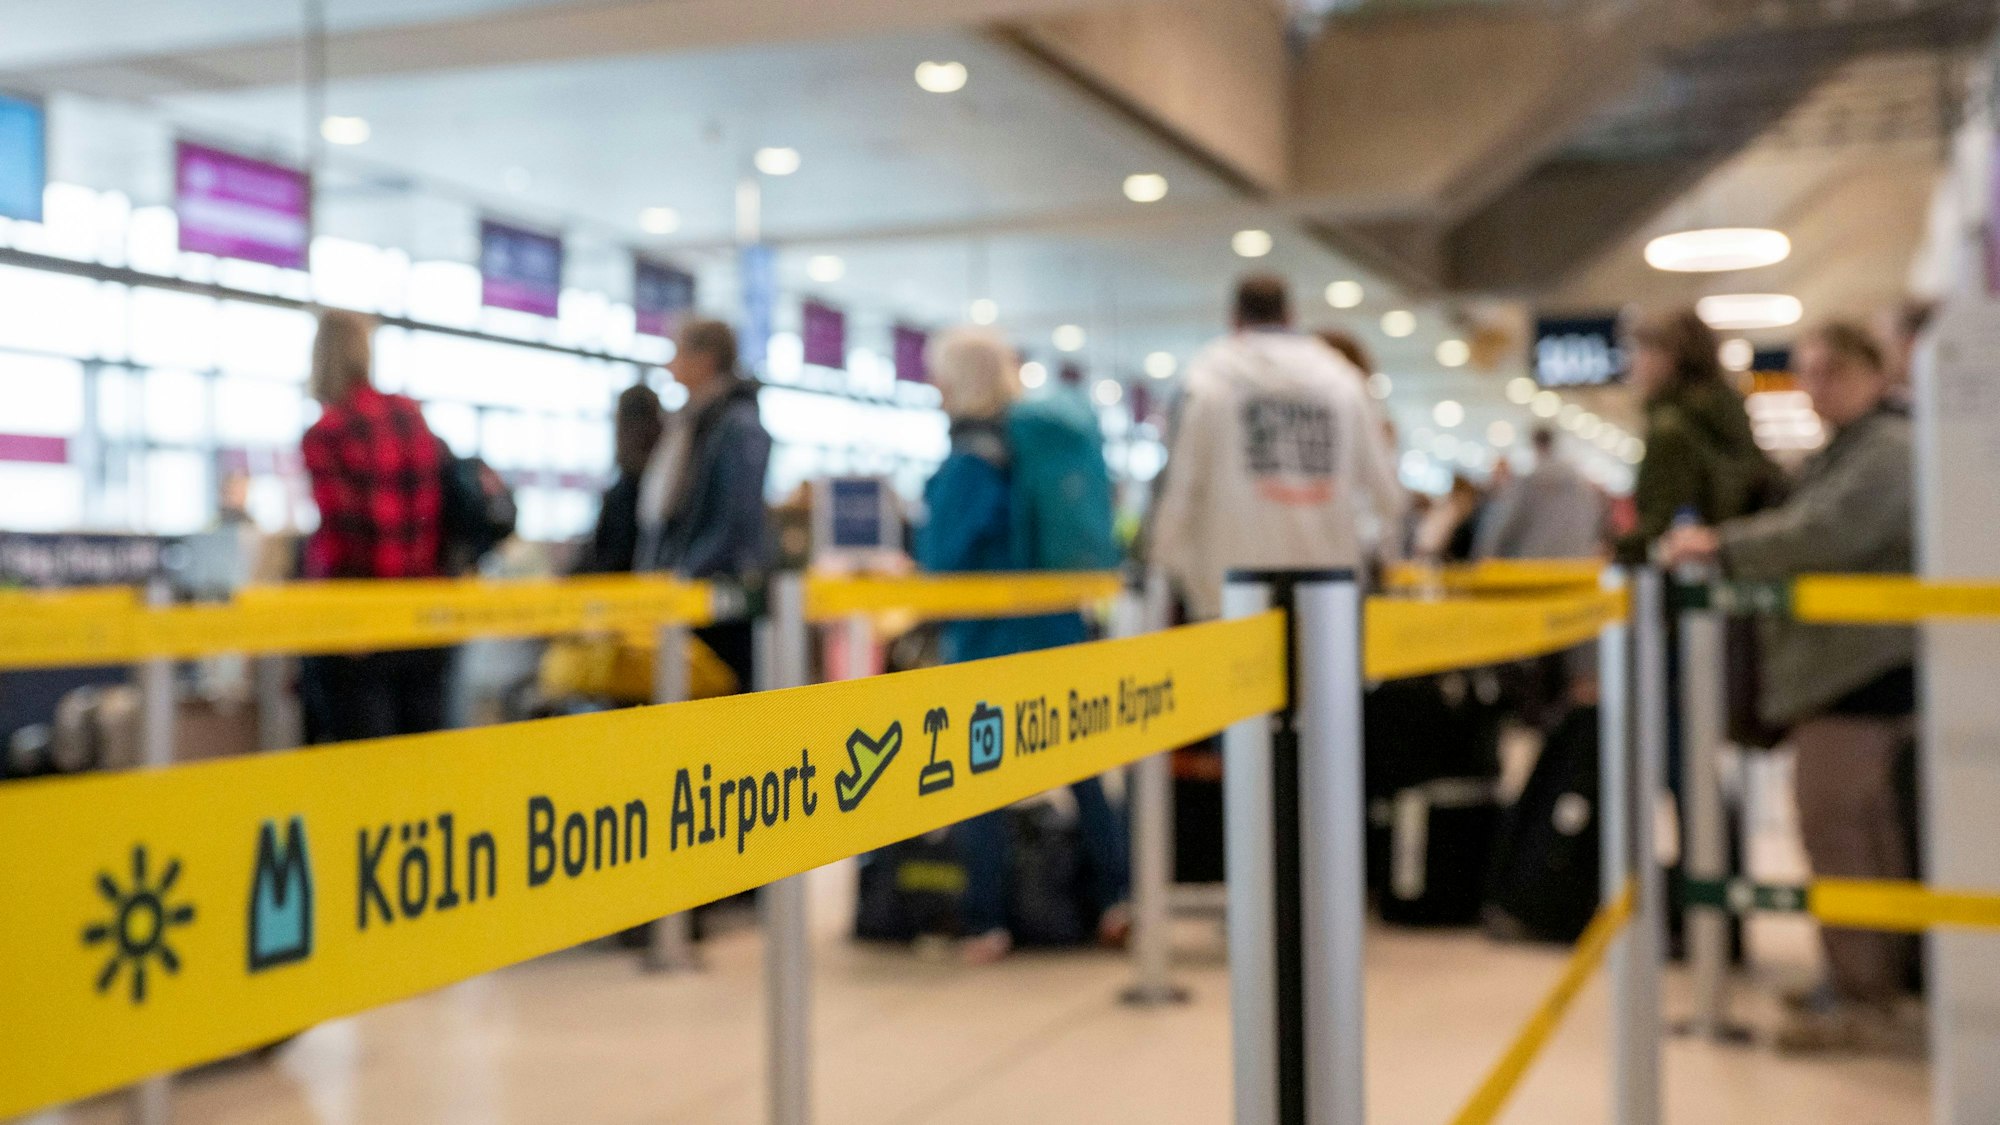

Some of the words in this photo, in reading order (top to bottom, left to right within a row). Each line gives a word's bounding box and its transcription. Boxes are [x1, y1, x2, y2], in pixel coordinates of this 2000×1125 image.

[1014, 695, 1060, 757] Köln
[1068, 689, 1110, 742] Bonn
[1117, 676, 1175, 732] Airport
[356, 812, 497, 931] Köln
[527, 796, 648, 887] Bonn
[670, 748, 818, 854] Airport
